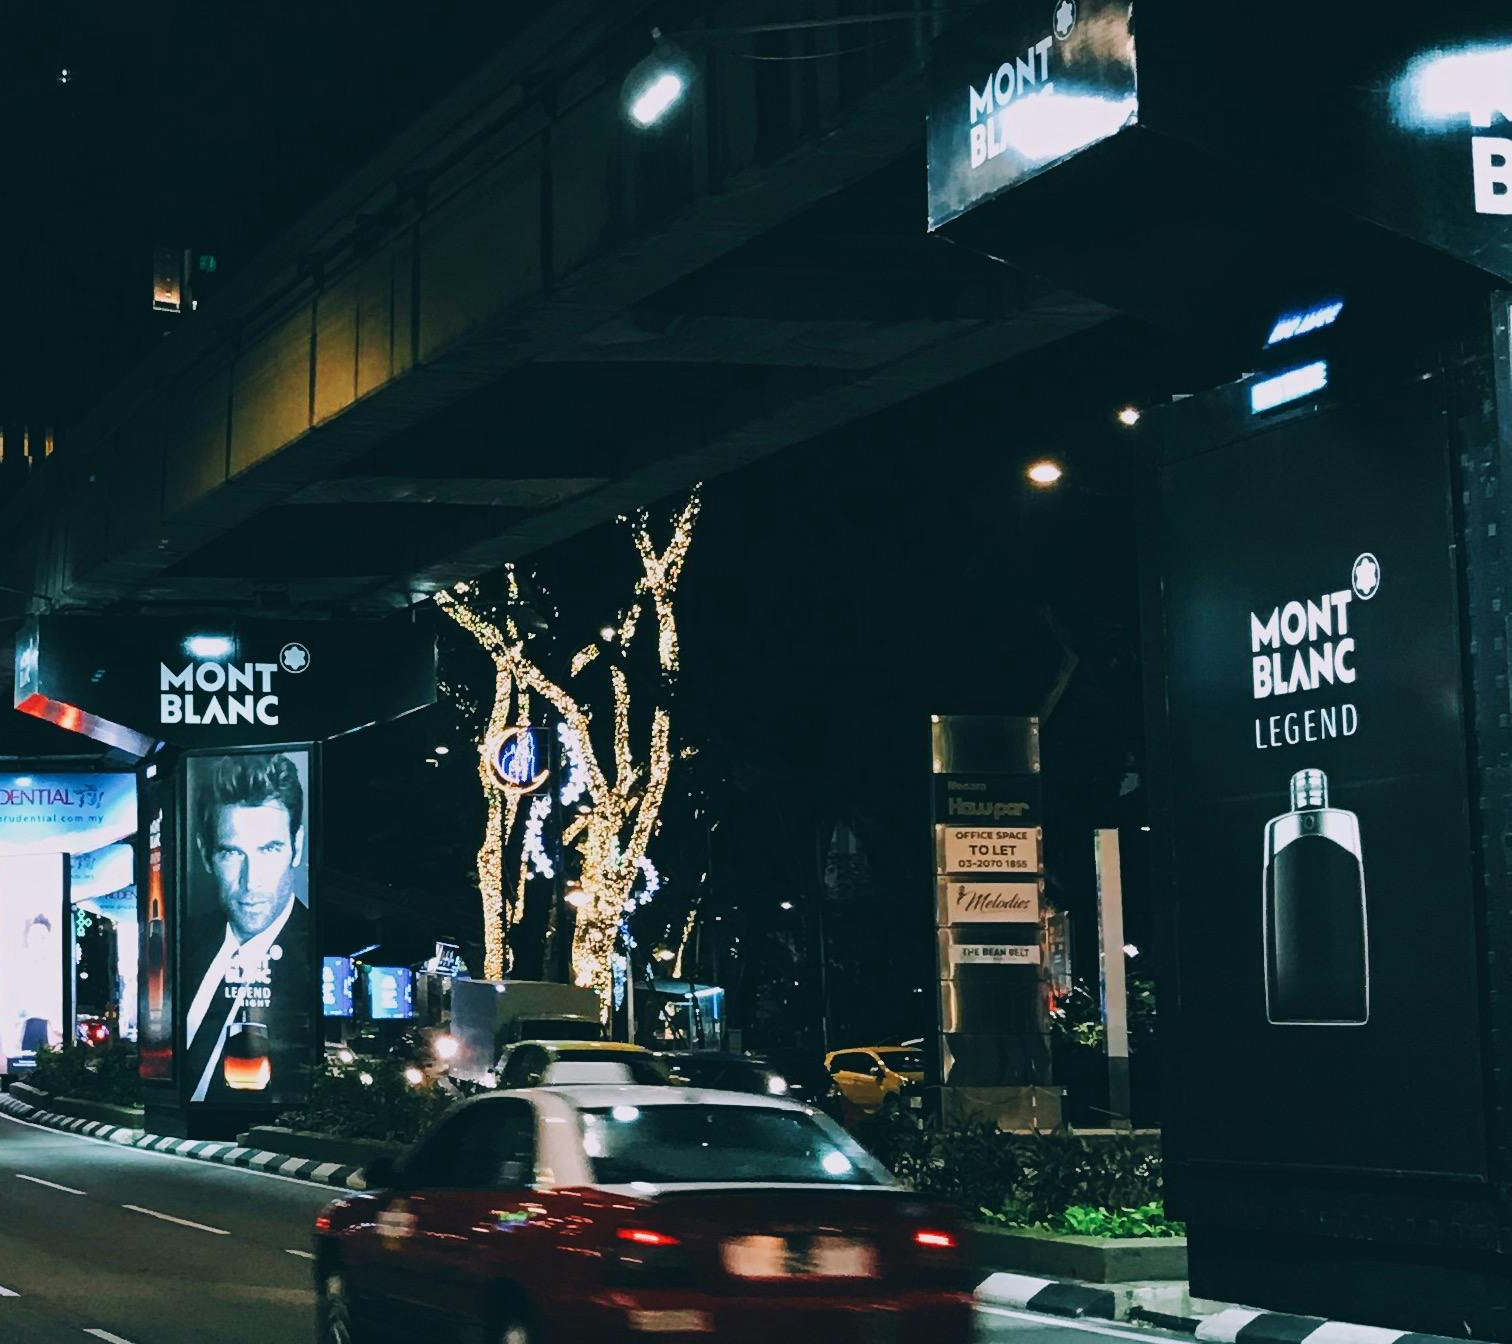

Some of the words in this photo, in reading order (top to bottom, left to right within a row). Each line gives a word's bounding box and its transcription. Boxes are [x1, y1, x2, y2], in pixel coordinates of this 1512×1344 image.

[969, 35, 1053, 124] MONT
[1251, 589, 1352, 652] MONT
[160, 661, 278, 693] MONT
[1252, 637, 1356, 699] BLANC
[160, 694, 279, 726] BLANC
[1255, 704, 1358, 749] LEGEND
[969, 845, 989, 855] TO
[992, 845, 1016, 855] LET
[996, 832, 1027, 840] SPACE
[965, 892, 1030, 912] Melodies
[963, 948, 979, 956] THE
